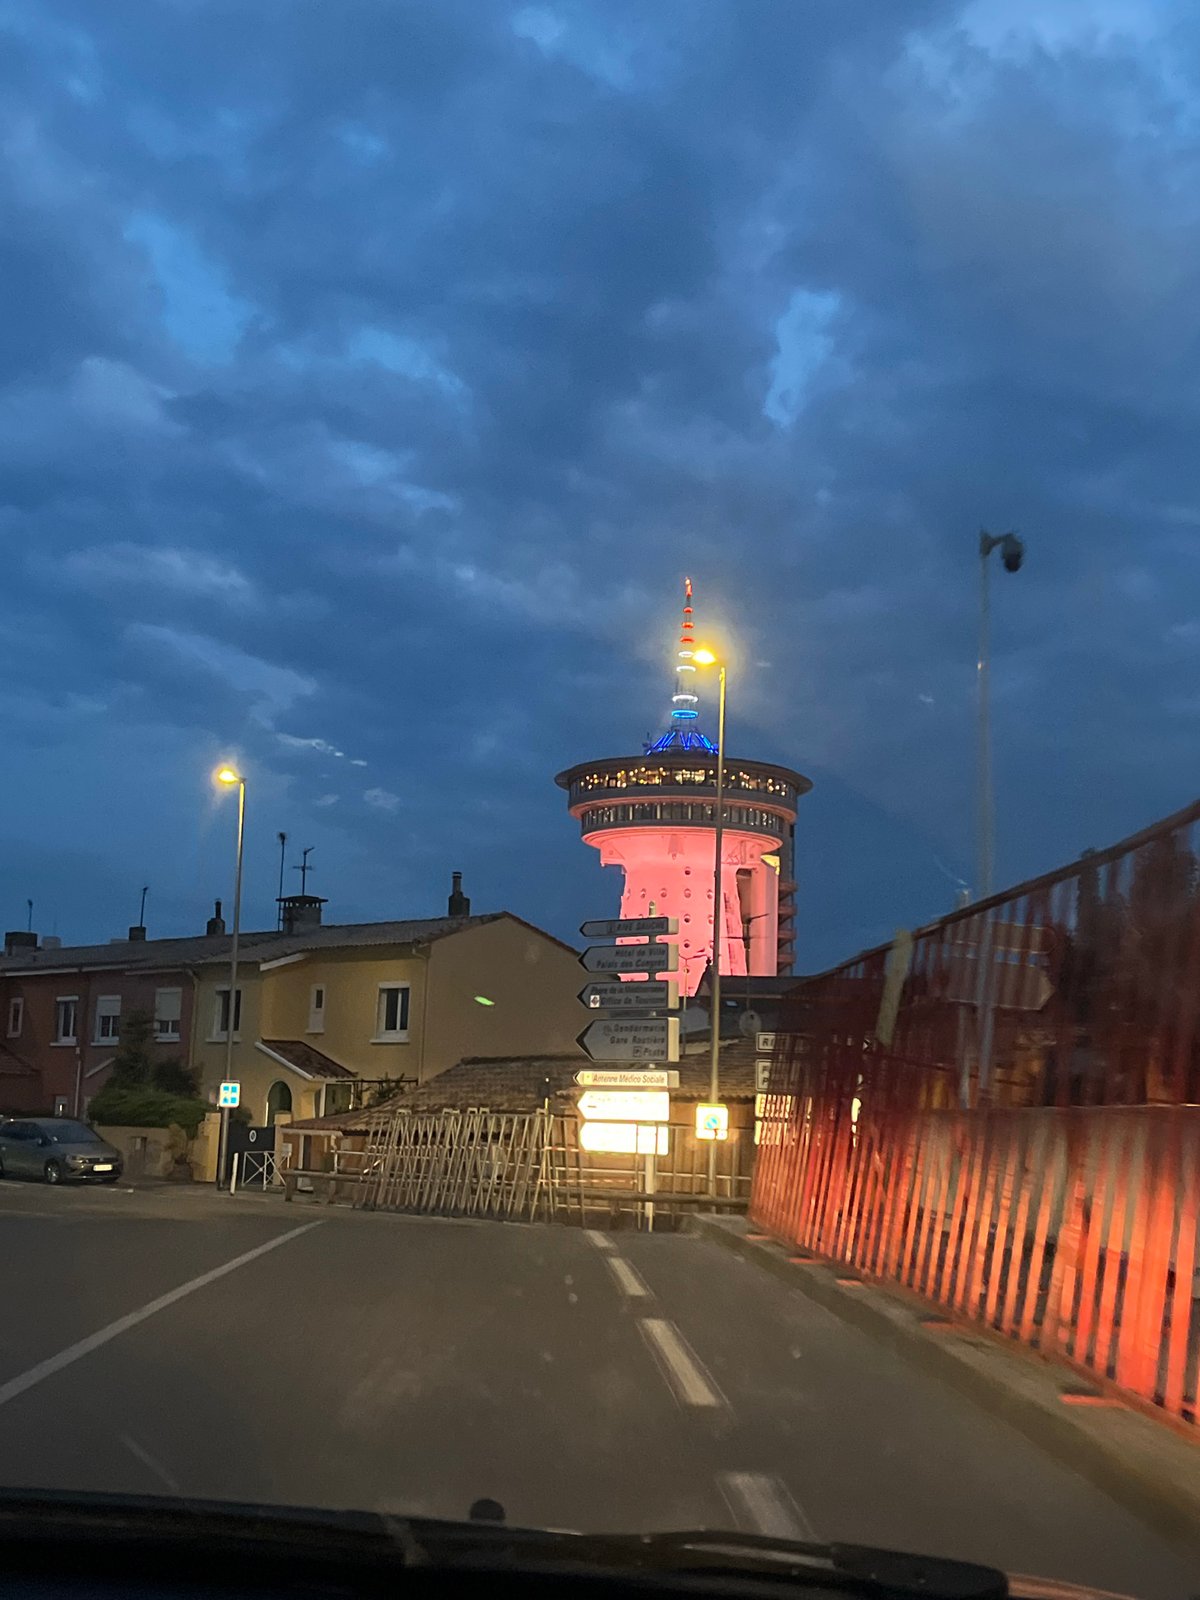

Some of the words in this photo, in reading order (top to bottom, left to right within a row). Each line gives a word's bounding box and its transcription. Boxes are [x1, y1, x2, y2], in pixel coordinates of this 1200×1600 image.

[596, 960, 618, 969] Palais
[613, 1023, 666, 1032] Gendarmerie
[610, 1035, 628, 1044] Gare
[592, 1073, 619, 1083] Antenne
[642, 1074, 666, 1084] Sociale
